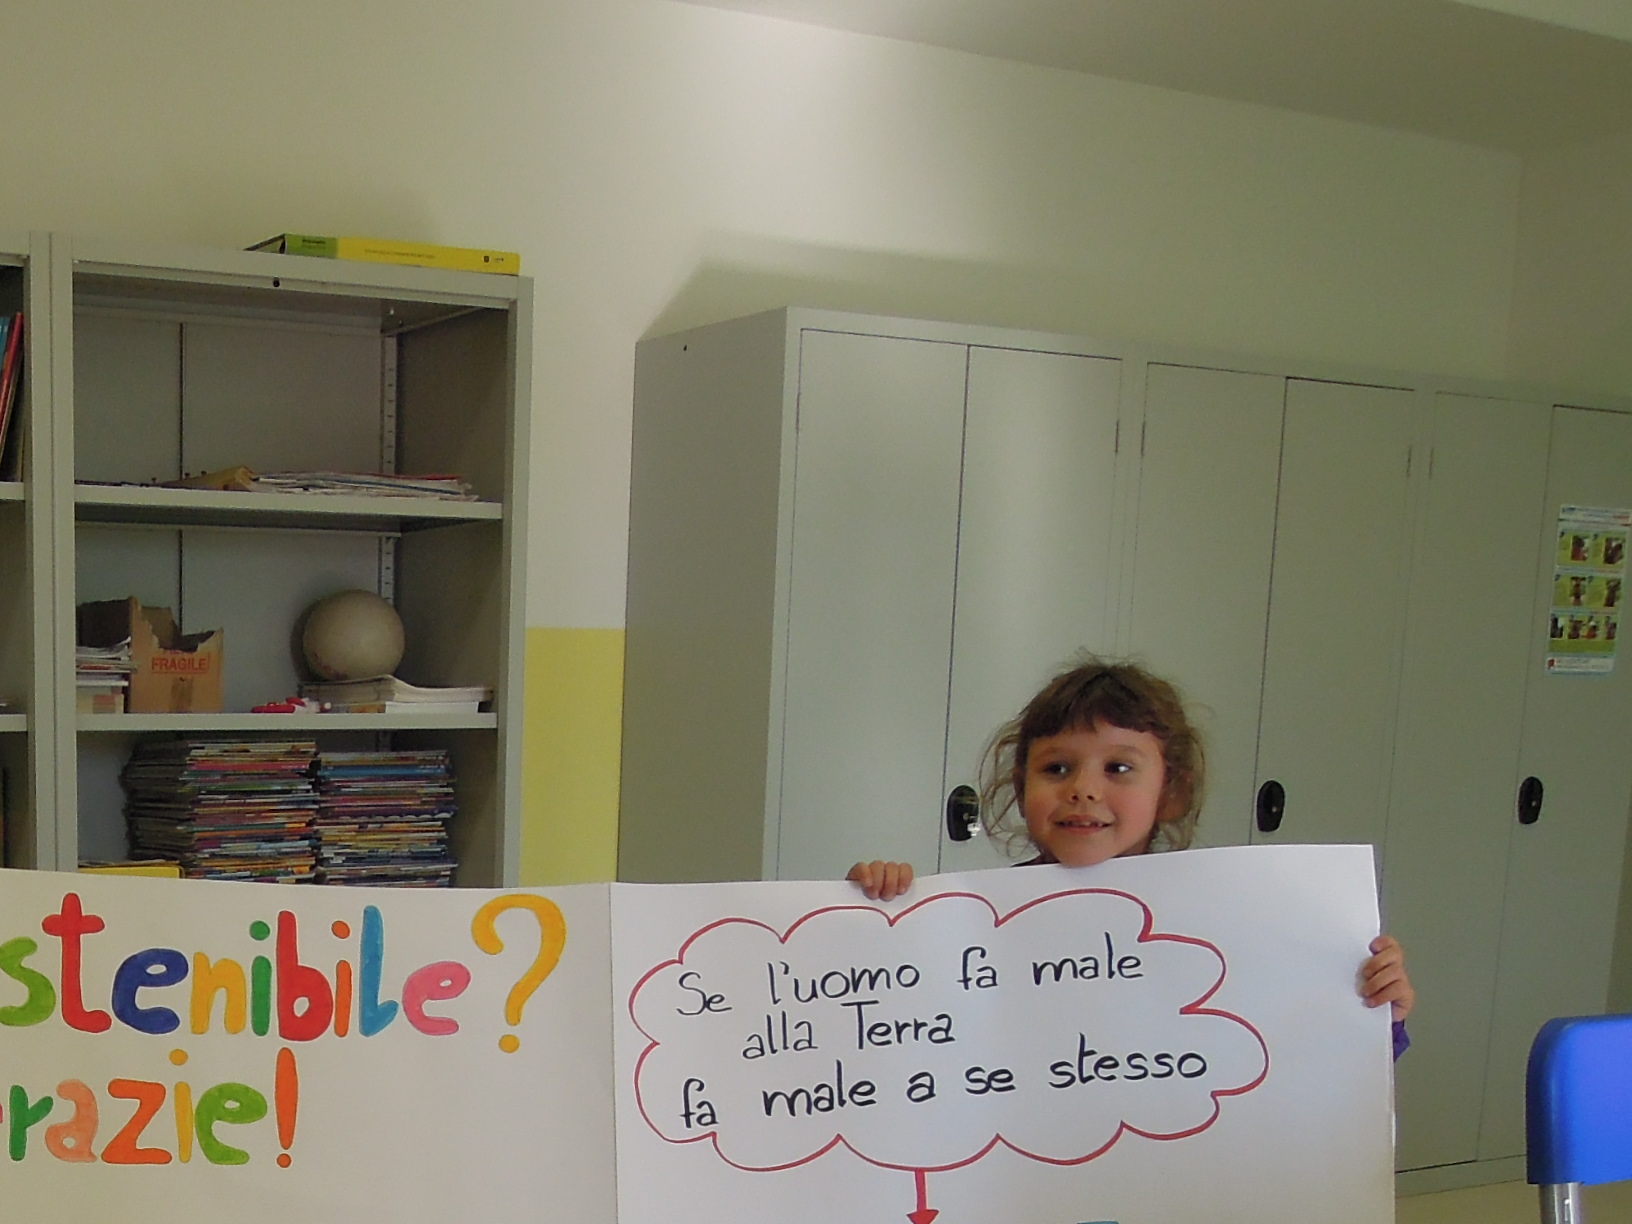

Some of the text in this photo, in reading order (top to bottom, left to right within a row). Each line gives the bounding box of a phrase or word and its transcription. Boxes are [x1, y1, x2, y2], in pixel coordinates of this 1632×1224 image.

[151, 656, 207, 671] FRAGILE
[676, 932, 1146, 1017] Se l'uomo fa male
[741, 1001, 956, 1061] alla Terra
[679, 1034, 1210, 1131] fa male a se stesso
